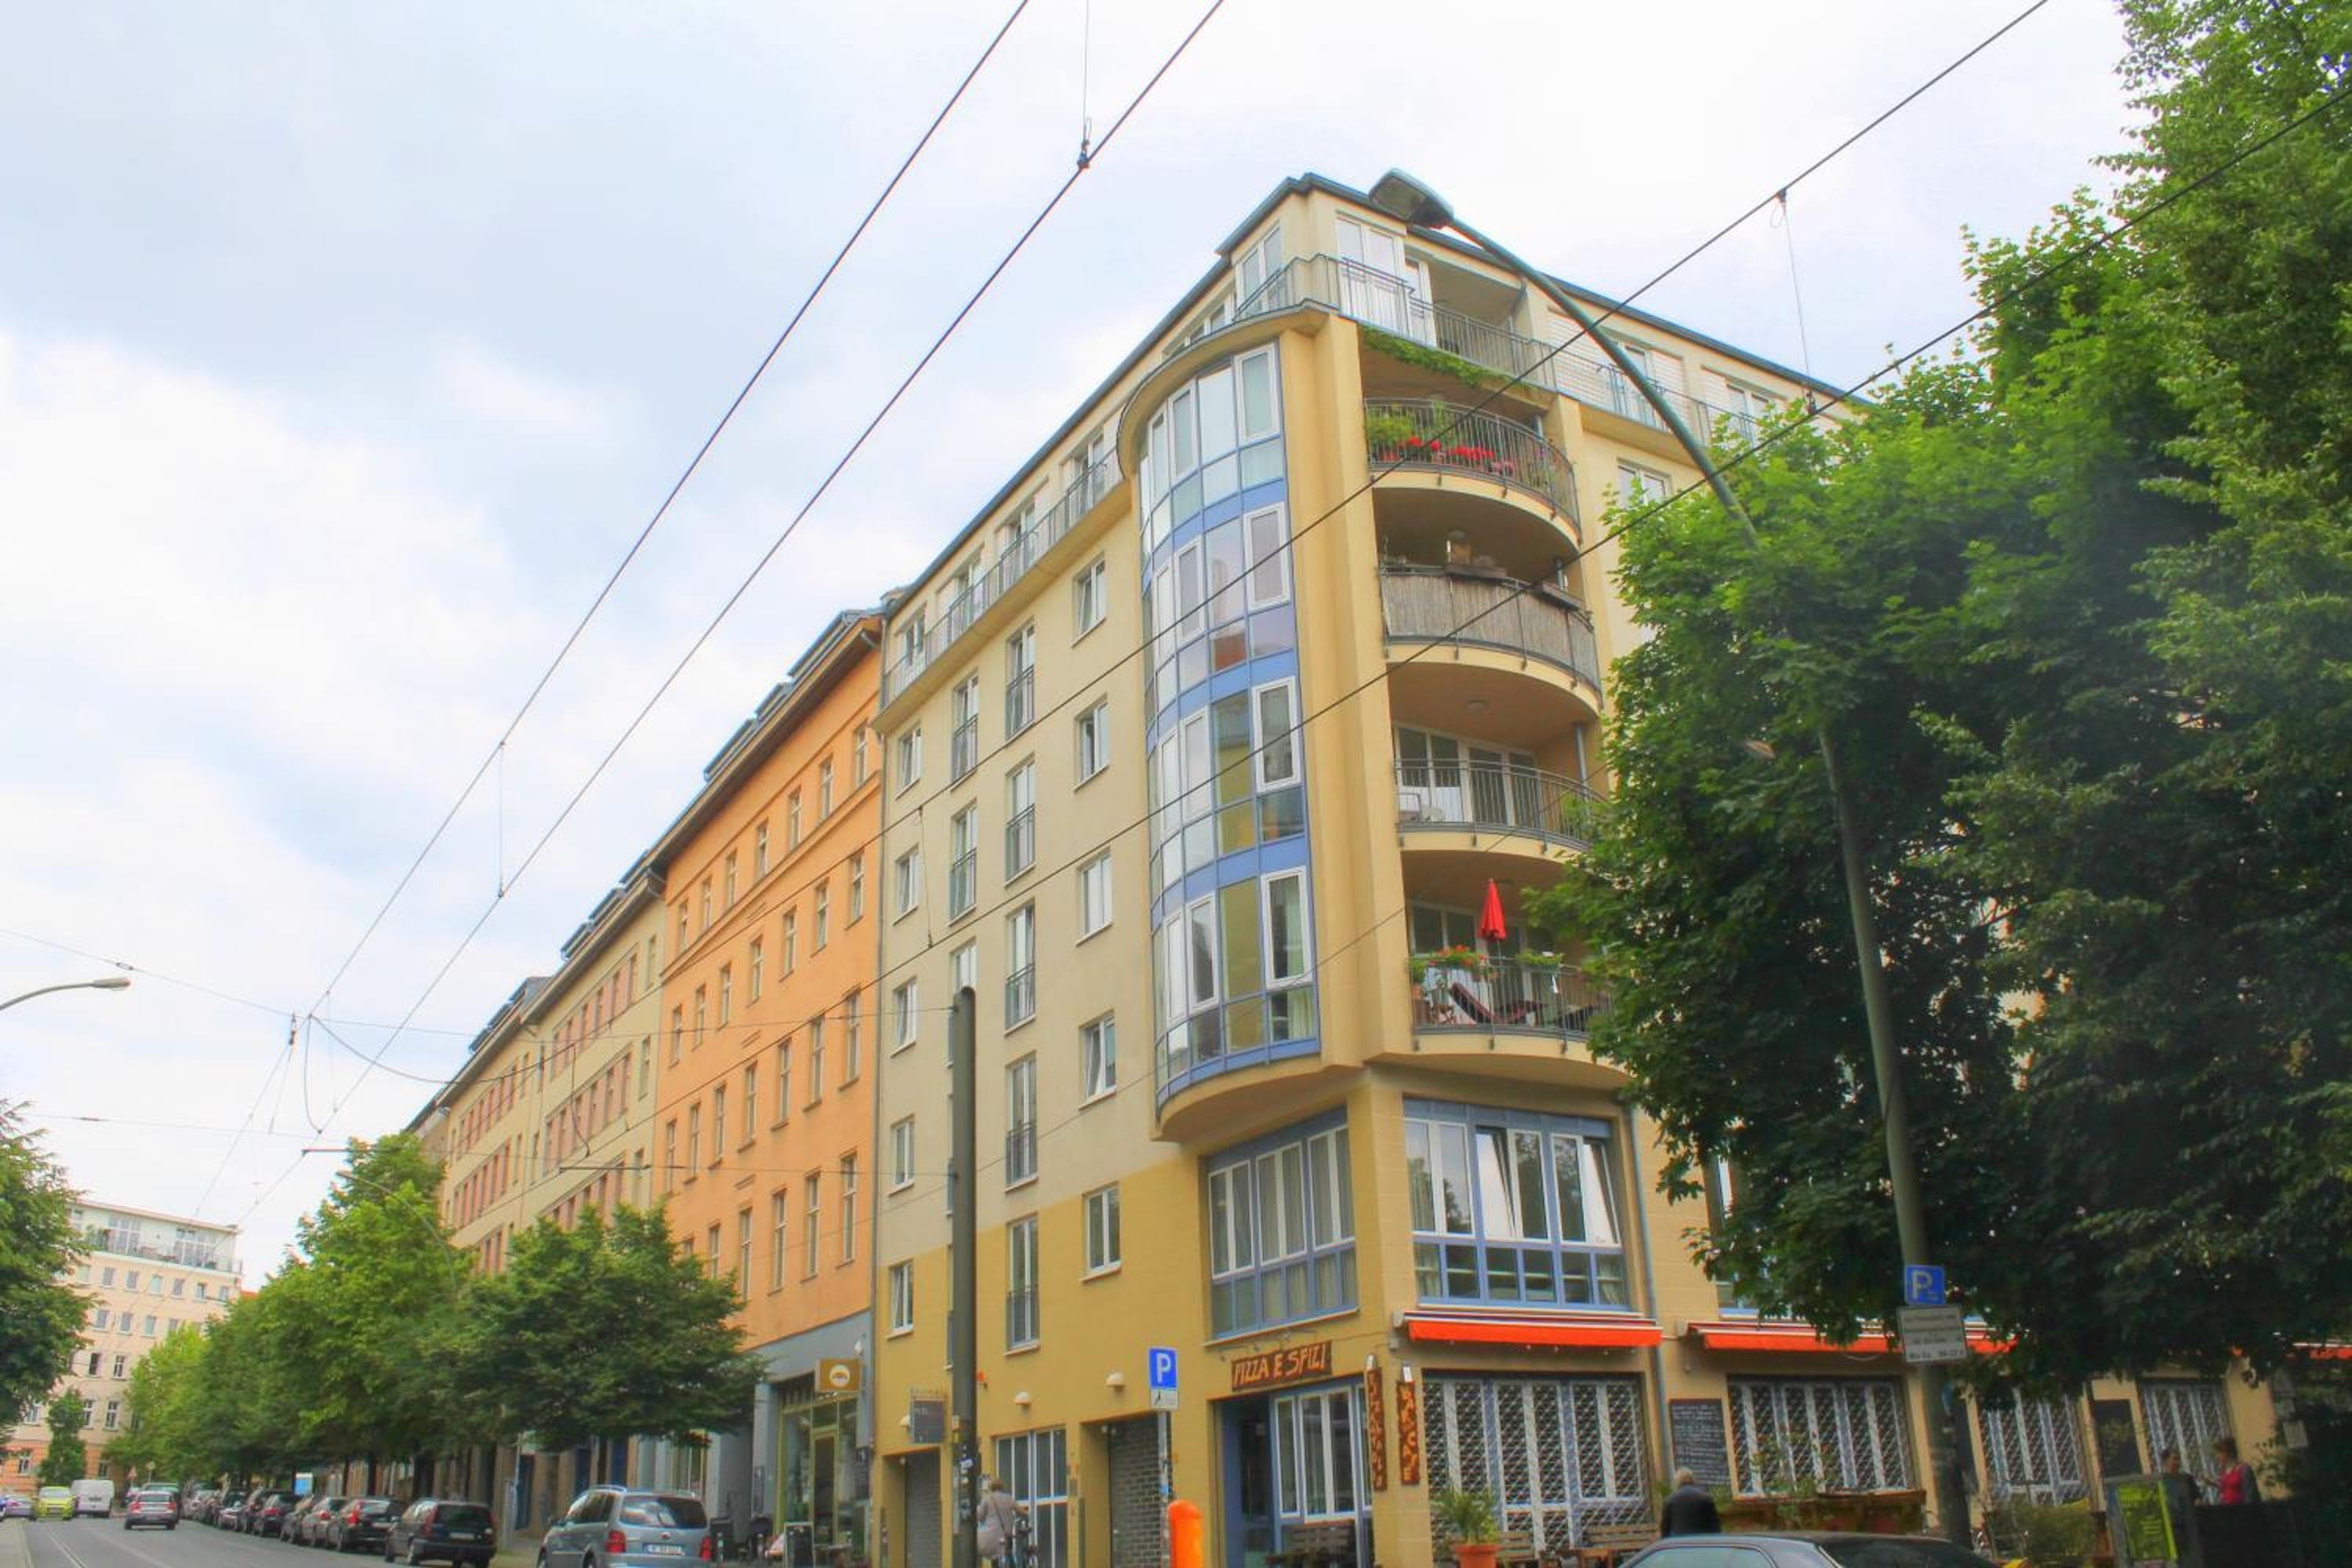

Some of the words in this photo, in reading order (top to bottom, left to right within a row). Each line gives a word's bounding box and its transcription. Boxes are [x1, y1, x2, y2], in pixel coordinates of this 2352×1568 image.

[1911, 1271, 1933, 1298] P
[1156, 1352, 1171, 1384] P
[1233, 1356, 1269, 1388] PIZZA
[1273, 1353, 1283, 1379] E
